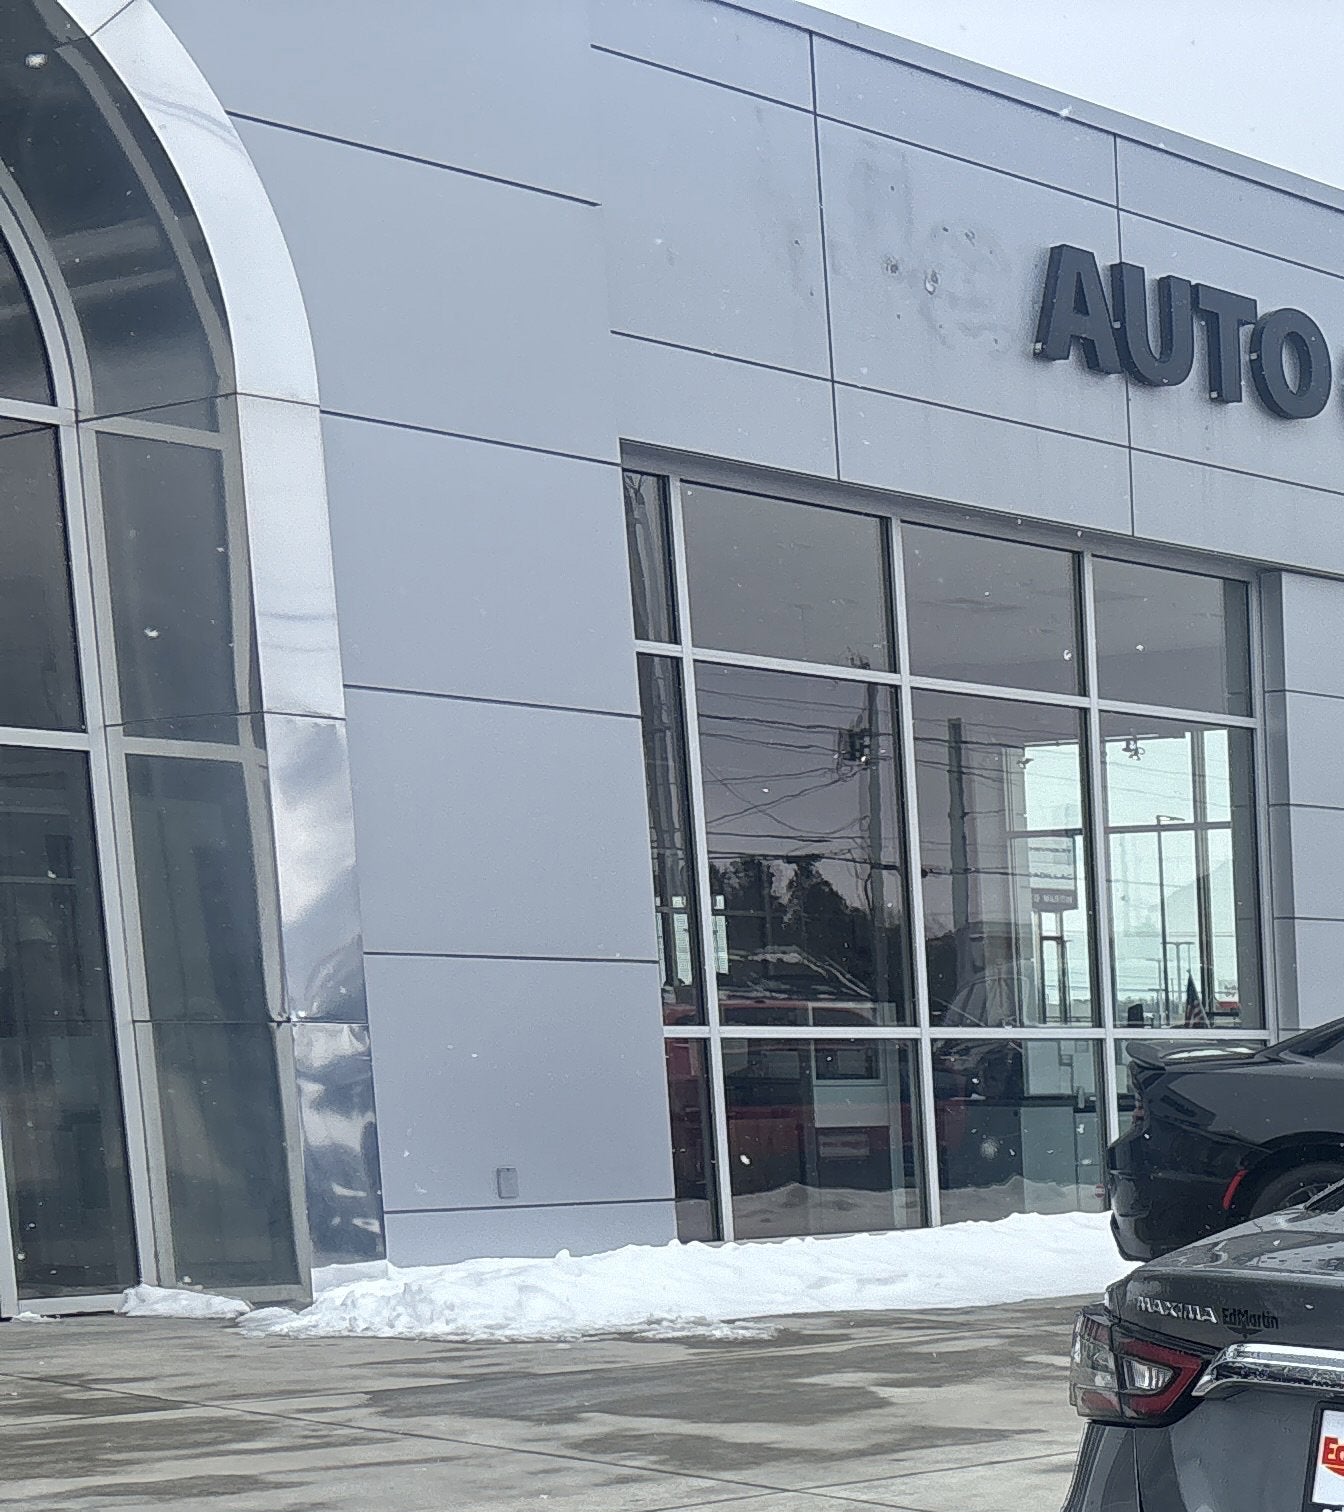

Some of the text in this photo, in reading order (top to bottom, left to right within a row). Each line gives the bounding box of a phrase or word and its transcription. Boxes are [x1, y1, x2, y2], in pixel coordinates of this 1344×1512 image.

[1034, 244, 1332, 420] AUTO
[1137, 1296, 1217, 1323] MAXIMA
[1221, 1307, 1279, 1330] EdMartin
